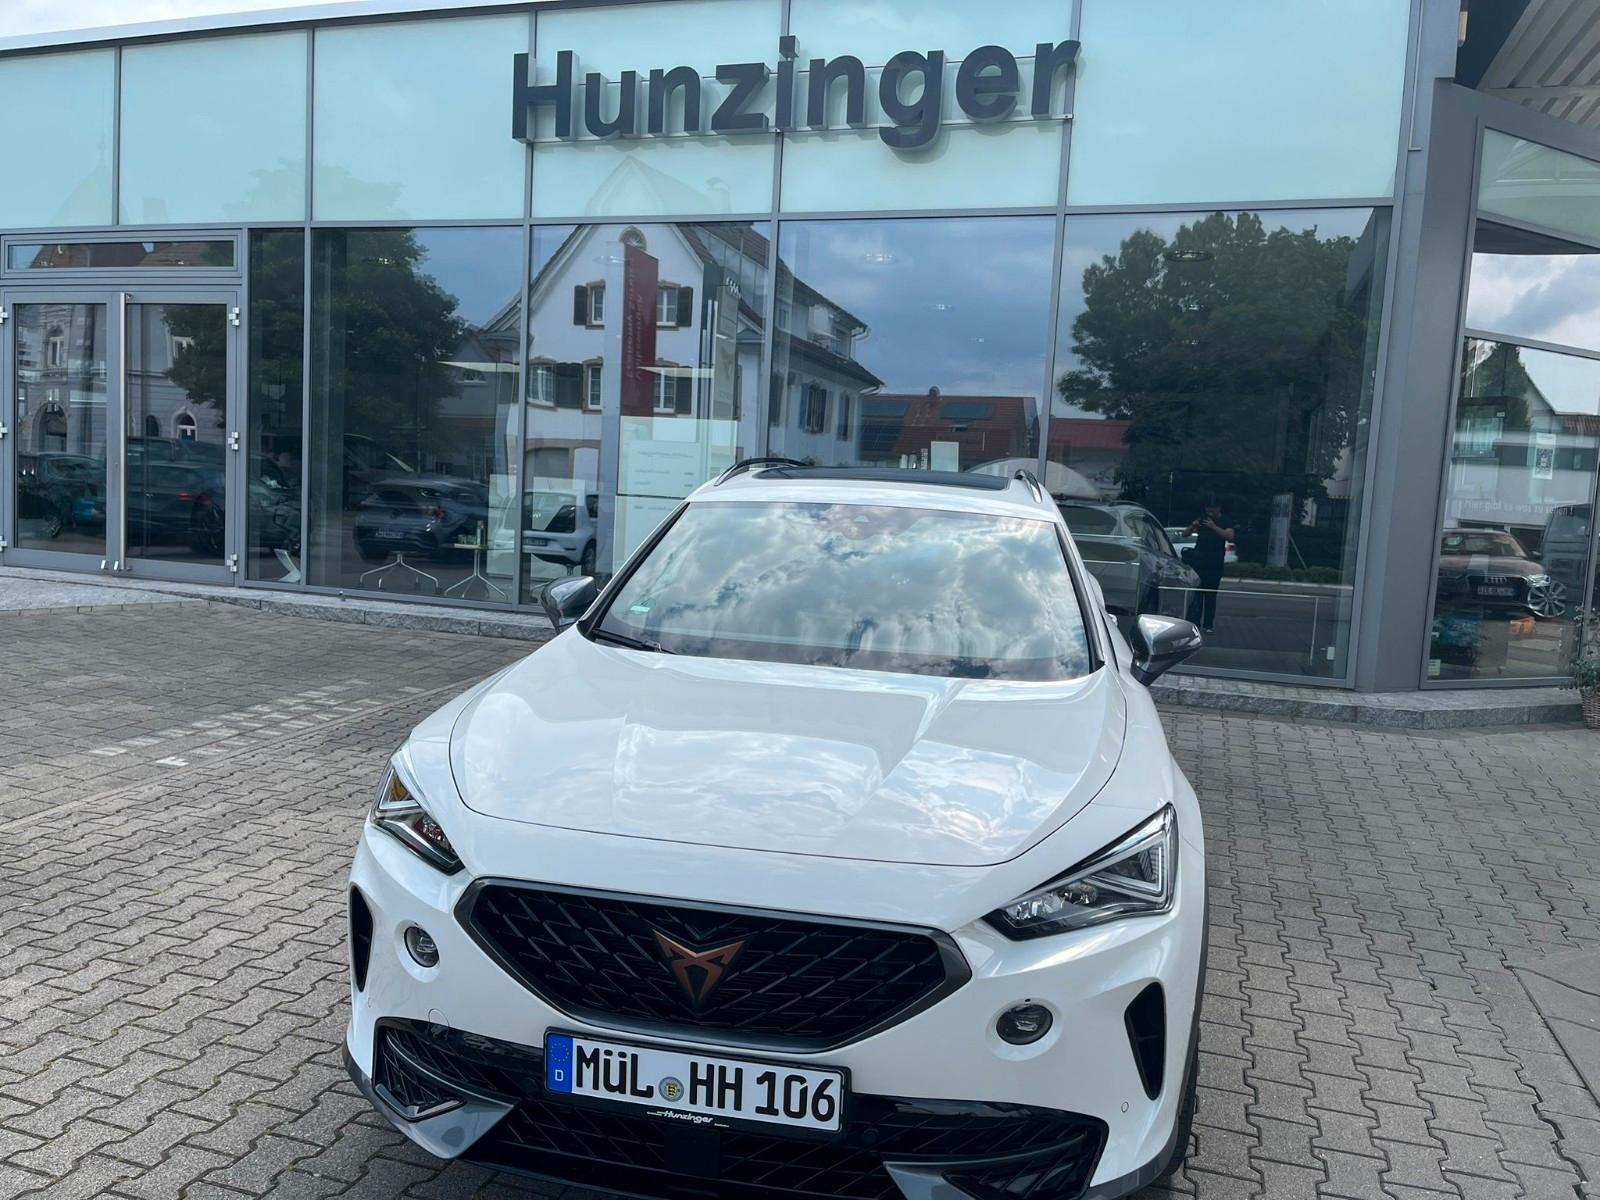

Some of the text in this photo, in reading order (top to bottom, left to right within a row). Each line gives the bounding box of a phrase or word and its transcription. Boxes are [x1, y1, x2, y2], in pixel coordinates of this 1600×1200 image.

[511, 35, 1081, 150] Hunzinger
[555, 1069, 564, 1082] D
[689, 1061, 743, 1111] HH
[755, 1071, 836, 1122] 106
[664, 1110, 713, 1124] Hunzinger
